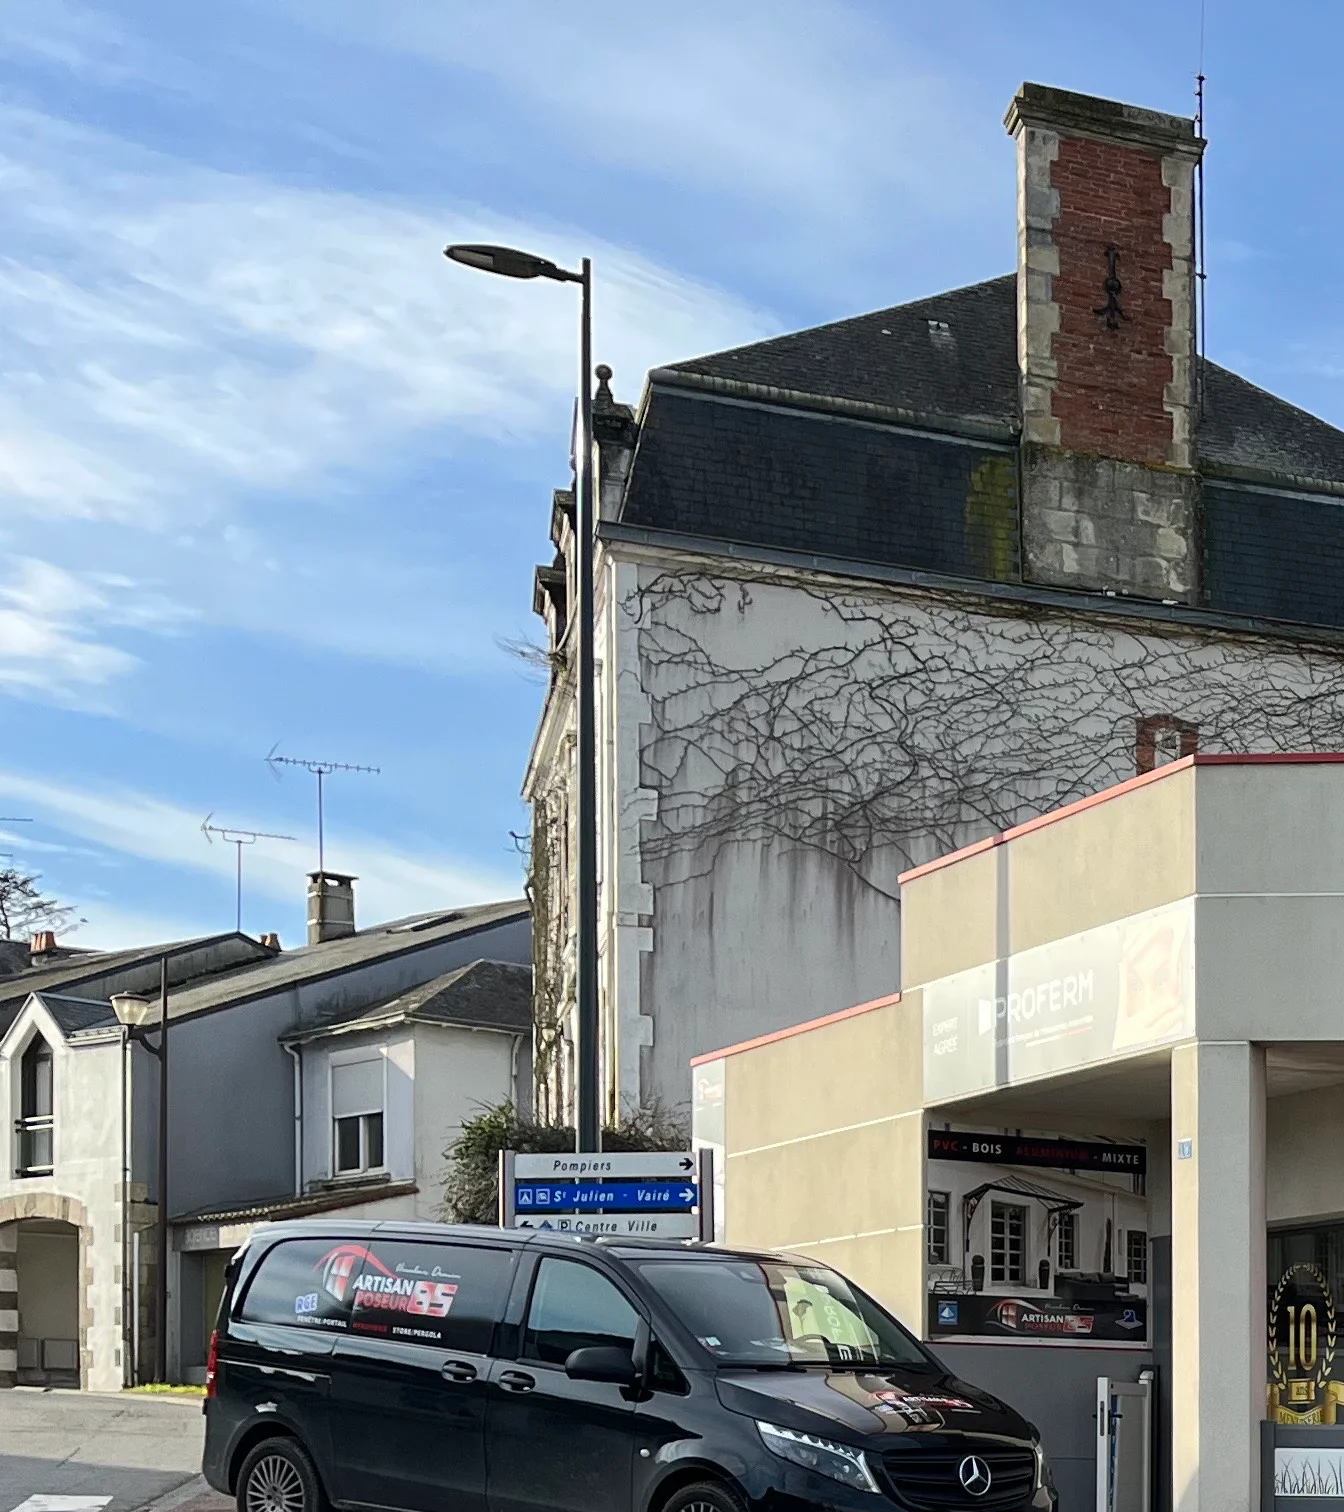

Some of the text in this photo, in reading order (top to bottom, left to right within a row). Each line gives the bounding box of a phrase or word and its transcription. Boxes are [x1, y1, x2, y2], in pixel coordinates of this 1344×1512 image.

[995, 969, 1093, 1026] PROFERM
[933, 1139, 959, 1150] PVC
[972, 1142, 1002, 1154] BOIS
[1102, 1152, 1139, 1165] MIXTE
[553, 1160, 611, 1173] Pompiers
[573, 1190, 614, 1202] Julien
[637, 1189, 670, 1202] Vairé
[576, 1221, 617, 1232] Centre
[628, 1220, 657, 1232] Ville
[353, 1275, 414, 1296] ARTISAN
[407, 1281, 458, 1317] 85
[1021, 1313, 1064, 1323] ARTISAN
[1287, 1303, 1317, 1371] 10
